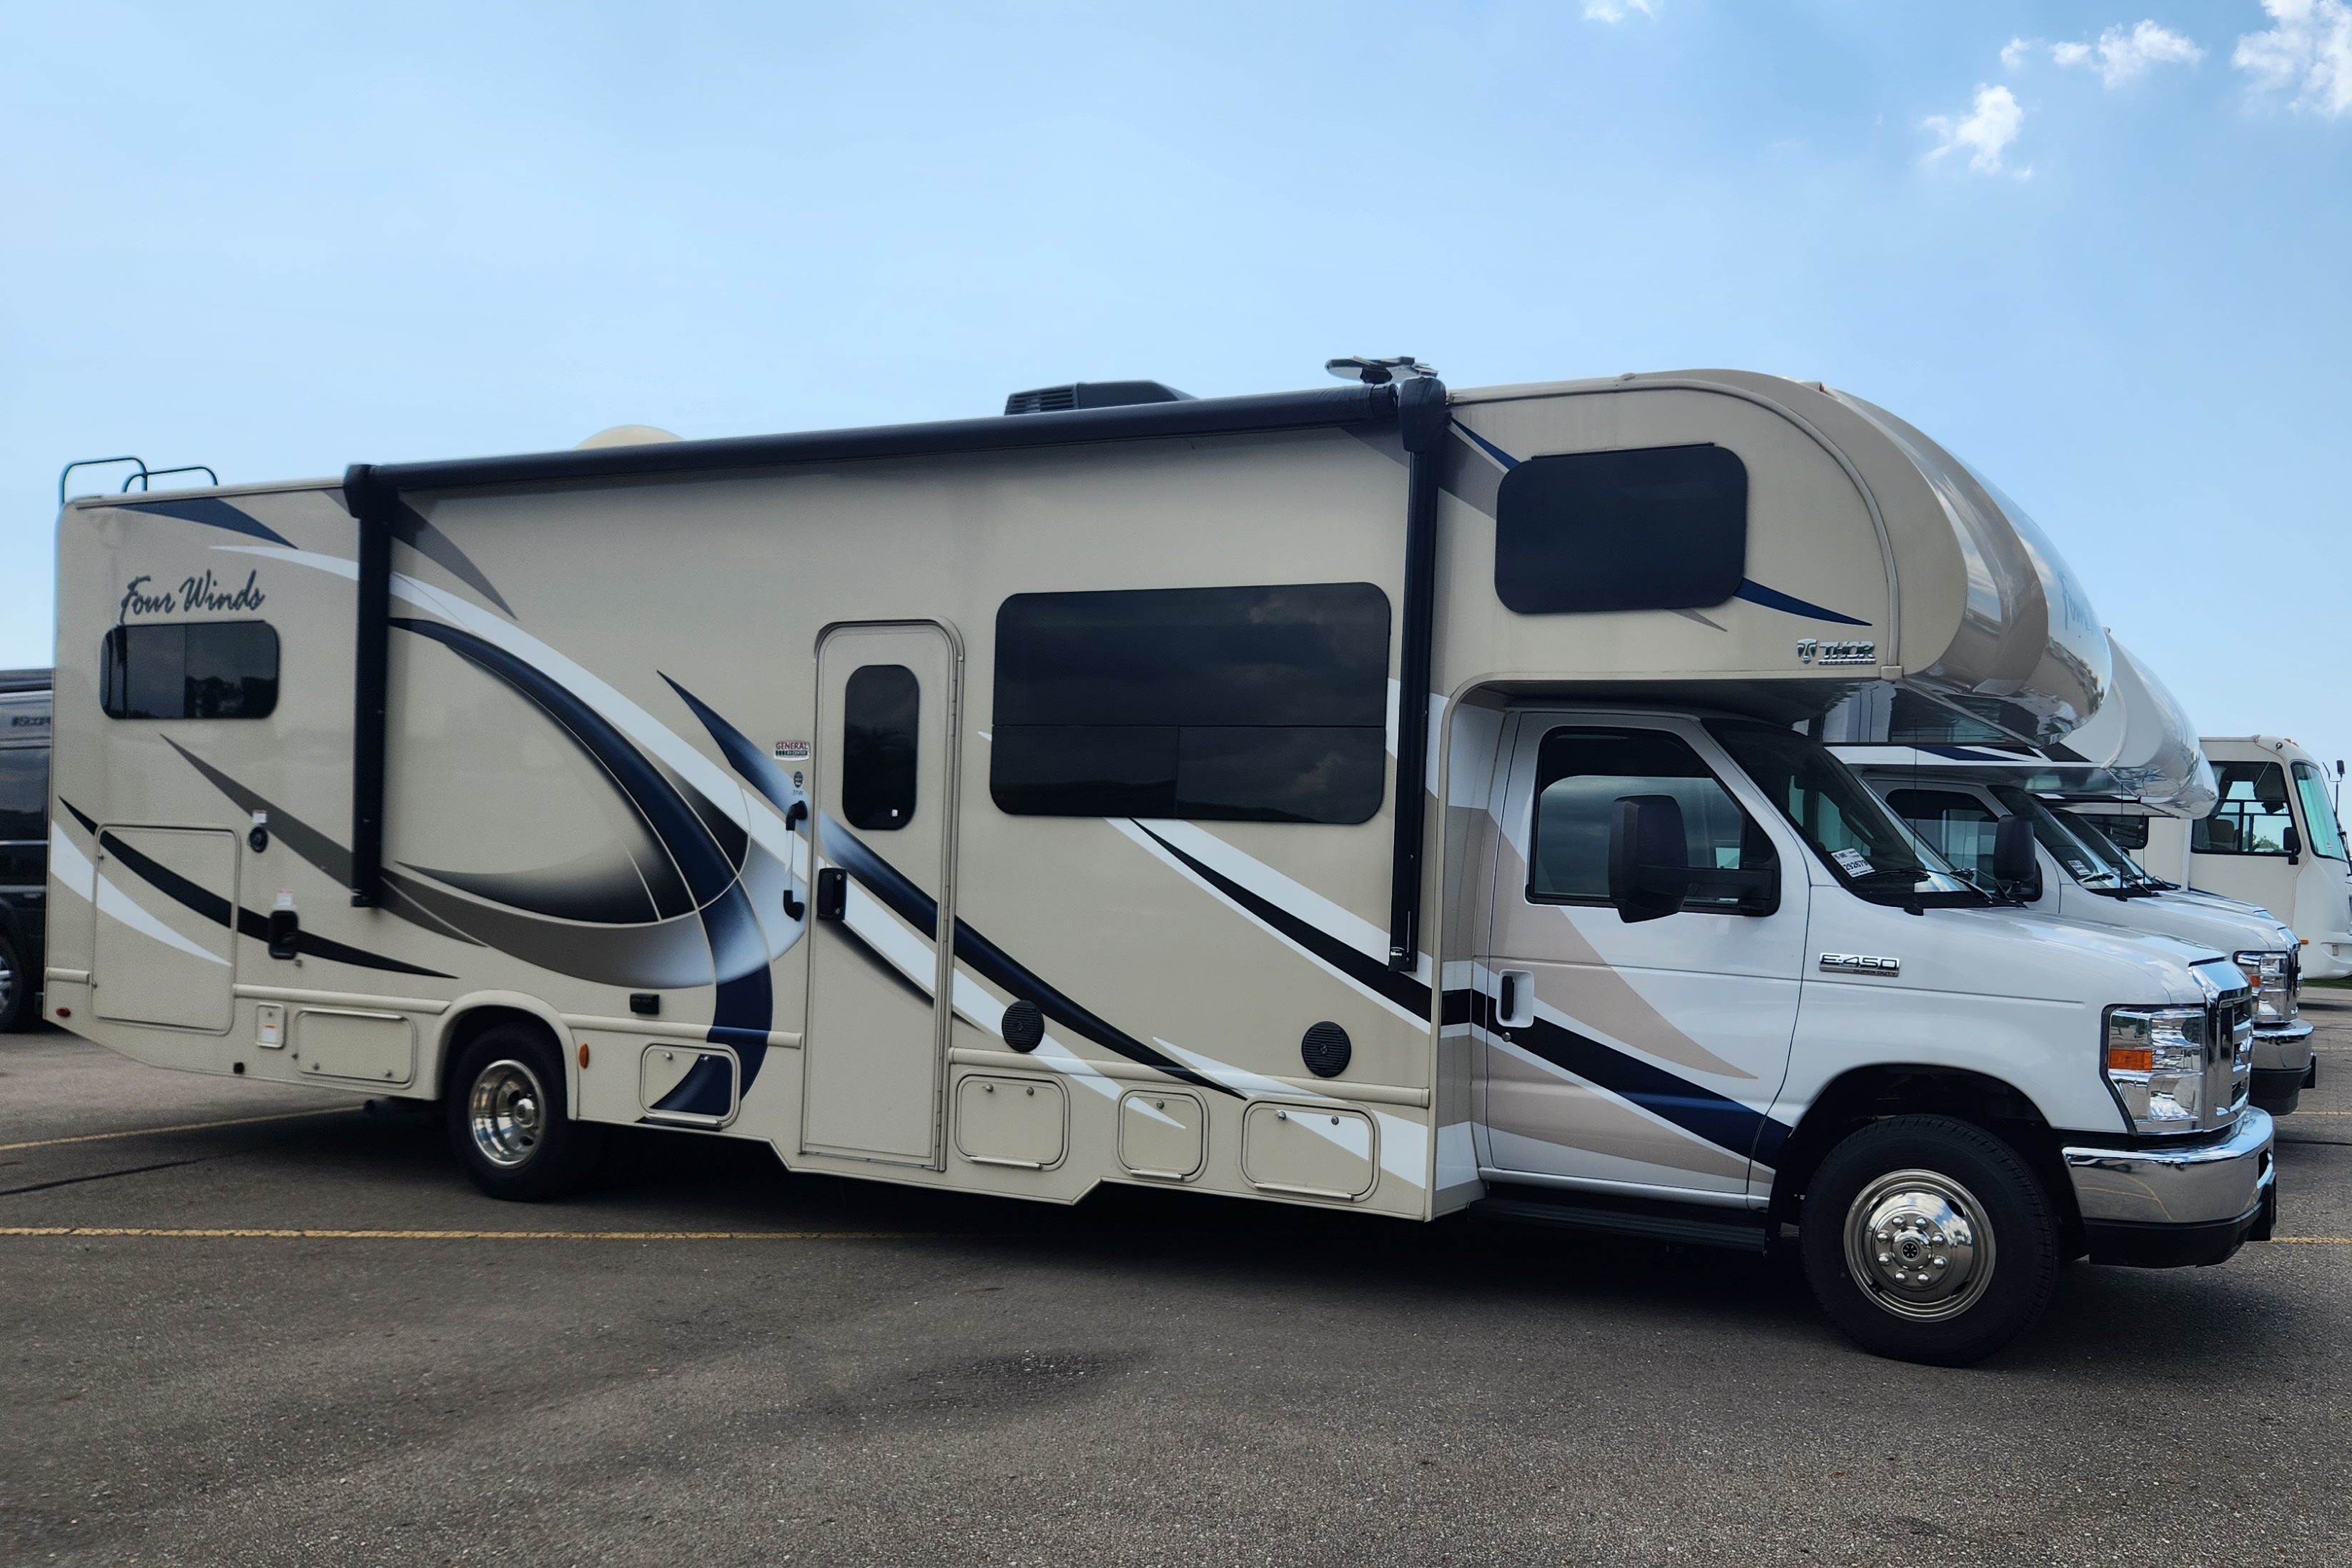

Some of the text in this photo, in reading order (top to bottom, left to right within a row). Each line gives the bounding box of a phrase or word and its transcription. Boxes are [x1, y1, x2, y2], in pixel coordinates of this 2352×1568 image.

[120, 569, 266, 625] Four Winds
[1819, 641, 1876, 659] THOR
[1820, 954, 1899, 970] E-450
